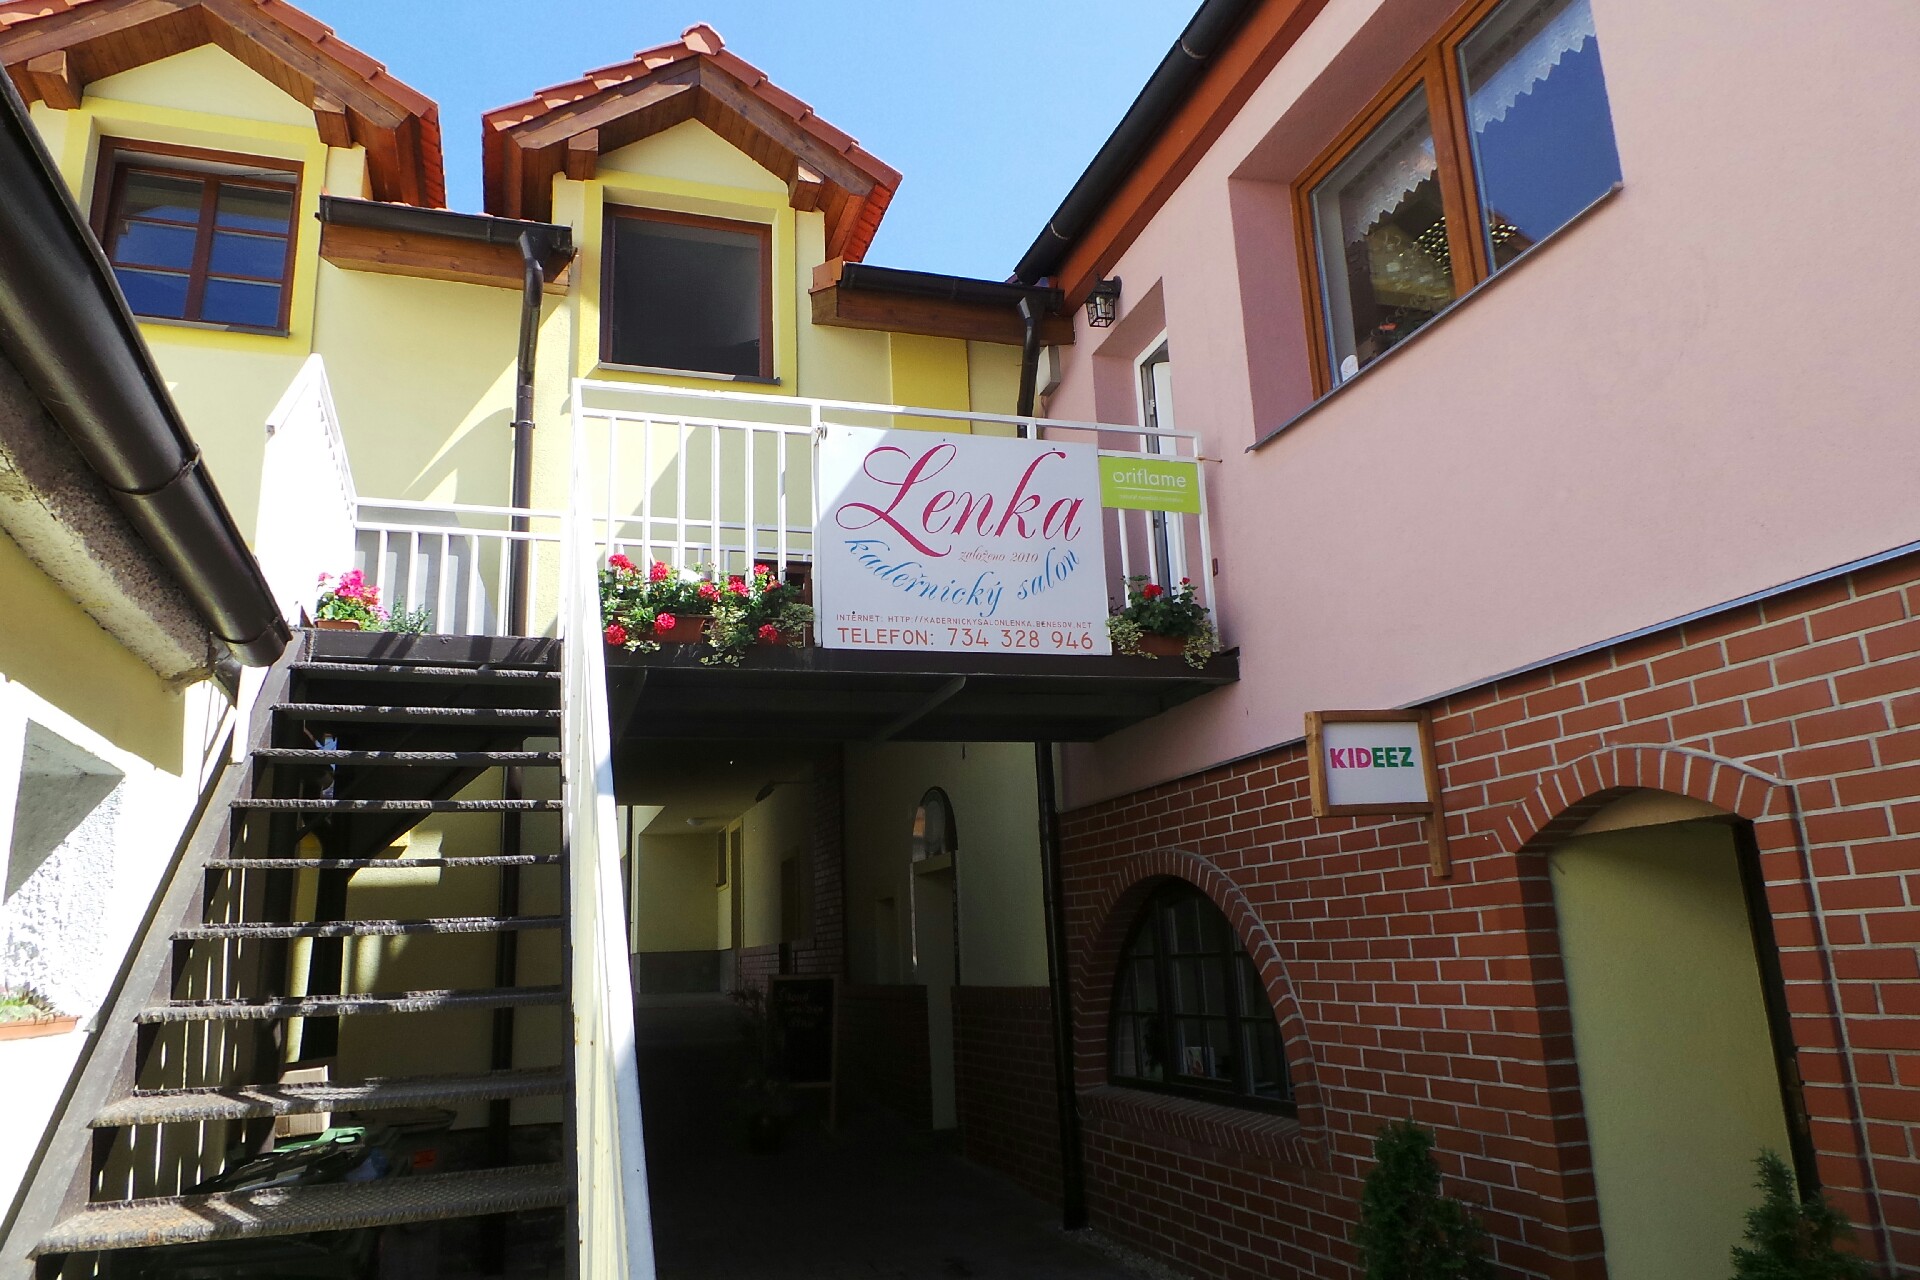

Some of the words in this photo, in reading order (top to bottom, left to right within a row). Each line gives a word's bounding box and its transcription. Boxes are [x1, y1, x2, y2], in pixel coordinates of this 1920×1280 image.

[1113, 468, 1187, 488] oriflame
[836, 443, 1085, 557] Lenka
[958, 545, 1006, 564] založeno
[1010, 551, 1039, 563] 2010
[1016, 547, 1080, 600] salon
[836, 614, 884, 623] INTERNET:
[837, 627, 934, 646] TELEFON:
[947, 627, 989, 647] 734
[1001, 629, 1040, 649] 328
[1051, 630, 1094, 650] 946
[1329, 746, 1415, 769] KIDEEZ
